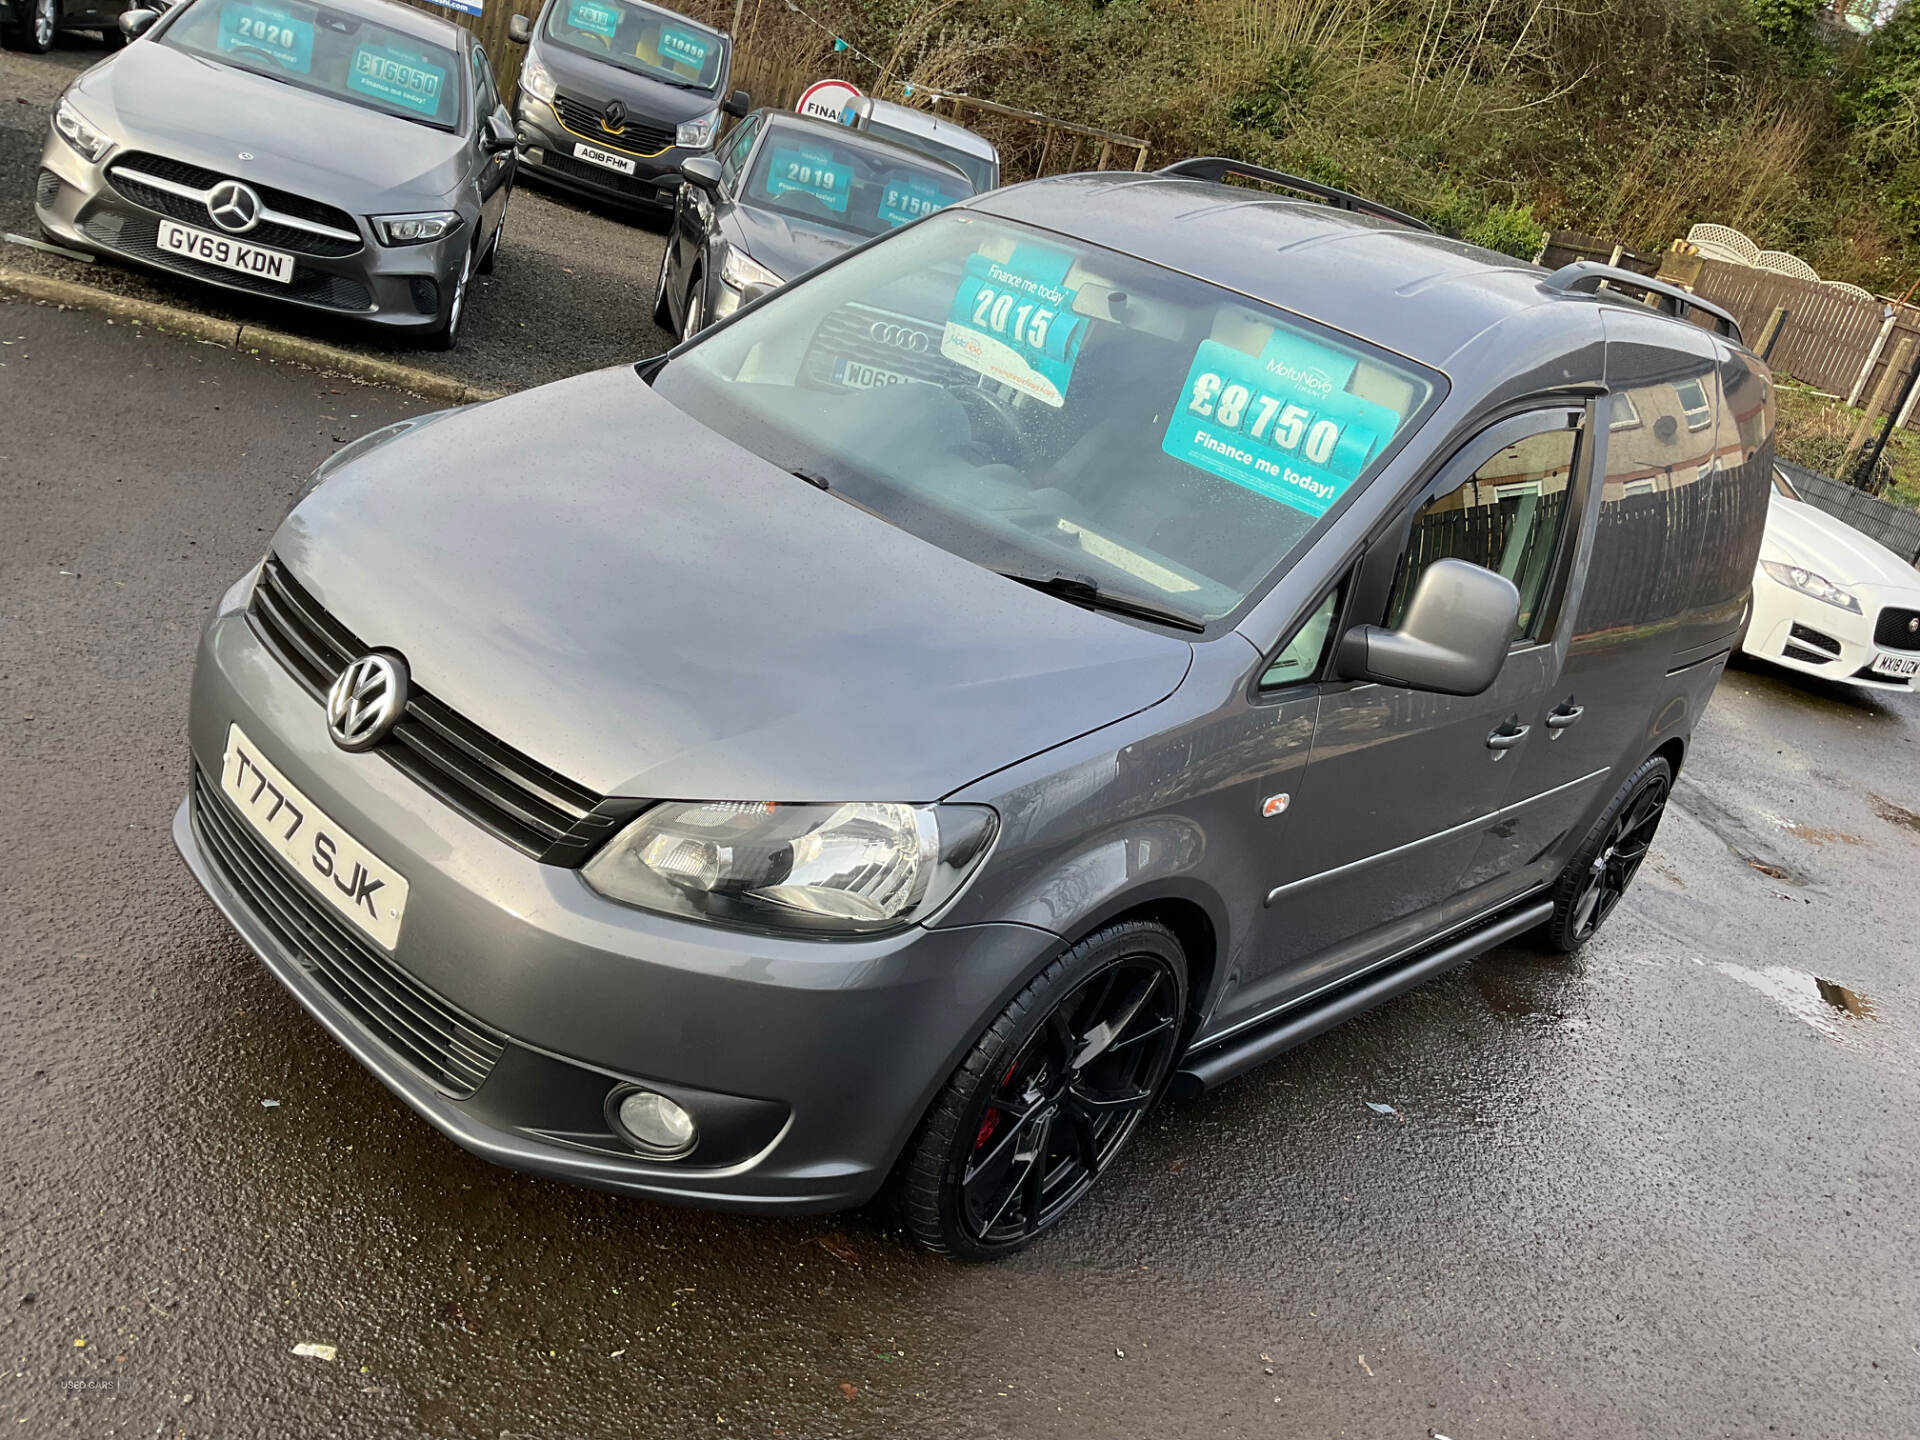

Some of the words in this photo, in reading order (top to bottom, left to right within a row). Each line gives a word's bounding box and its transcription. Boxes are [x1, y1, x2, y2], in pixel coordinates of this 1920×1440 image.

[240, 17, 294, 48] 2020
[357, 51, 438, 96] £16950
[361, 78, 389, 92] Finance
[807, 102, 842, 121] FINA
[581, 148, 606, 162] AO18
[605, 155, 628, 170] FHM
[787, 163, 835, 190] 2019
[168, 227, 230, 263] GV69
[235, 246, 283, 277] KDN
[988, 264, 1022, 288] Finance
[1021, 279, 1038, 294] me
[972, 289, 1054, 349] 2015
[1265, 358, 1332, 393] MotoNovo
[1189, 372, 1338, 464] £8750
[1194, 430, 1253, 465] Finance
[1254, 458, 1281, 477] me
[1283, 467, 1335, 500] today!
[1879, 656, 1903, 672] MX18
[235, 746, 304, 841] T777
[311, 831, 387, 921] SJK
